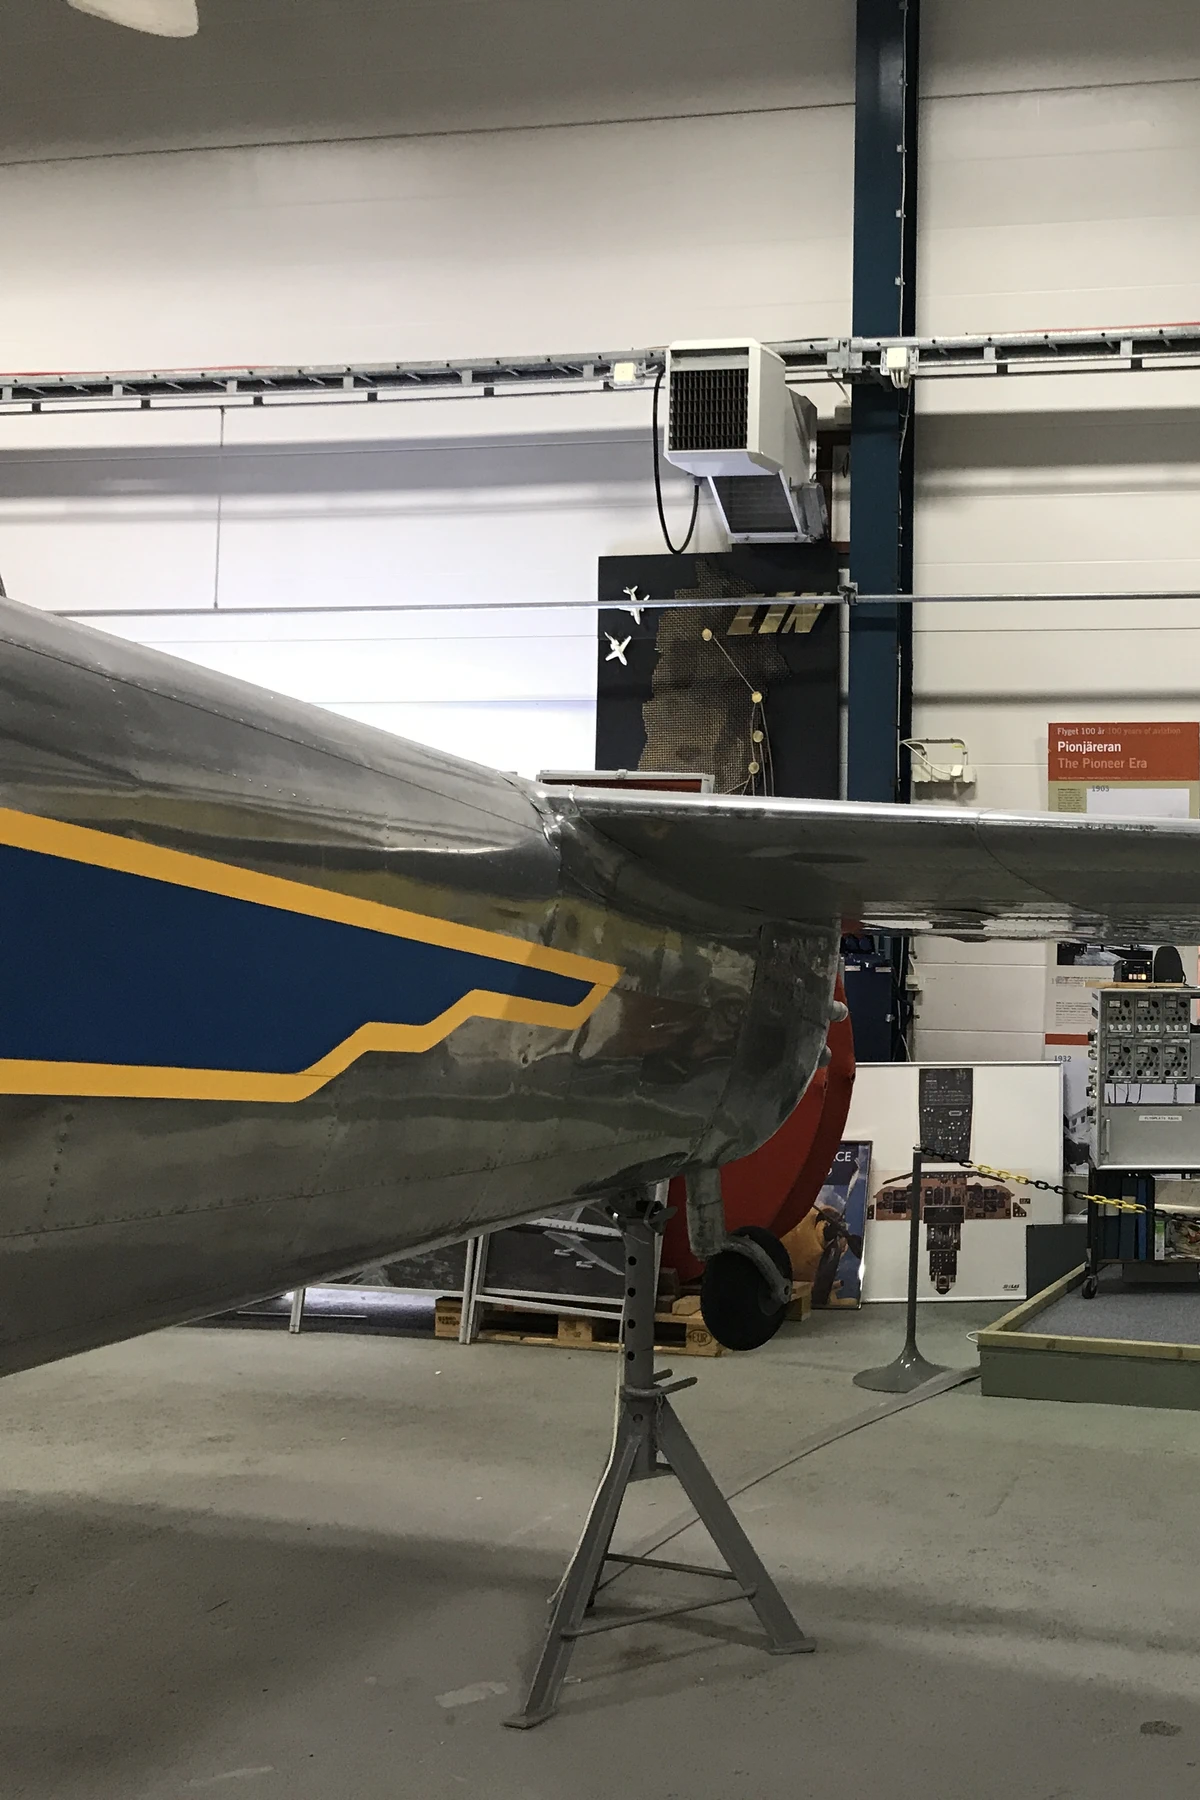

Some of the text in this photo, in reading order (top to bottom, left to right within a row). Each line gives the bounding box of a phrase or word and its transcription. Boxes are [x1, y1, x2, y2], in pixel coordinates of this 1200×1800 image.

[1057, 727, 1079, 736] Flyget
[1081, 727, 1096, 735] 100
[1097, 726, 1105, 735] år
[1108, 727, 1121, 735] 100
[1144, 727, 1151, 735] of
[1057, 741, 1122, 754] Pionjäreran
[1057, 757, 1148, 769] The Pioneer Era
[833, 1151, 852, 1162] CE
